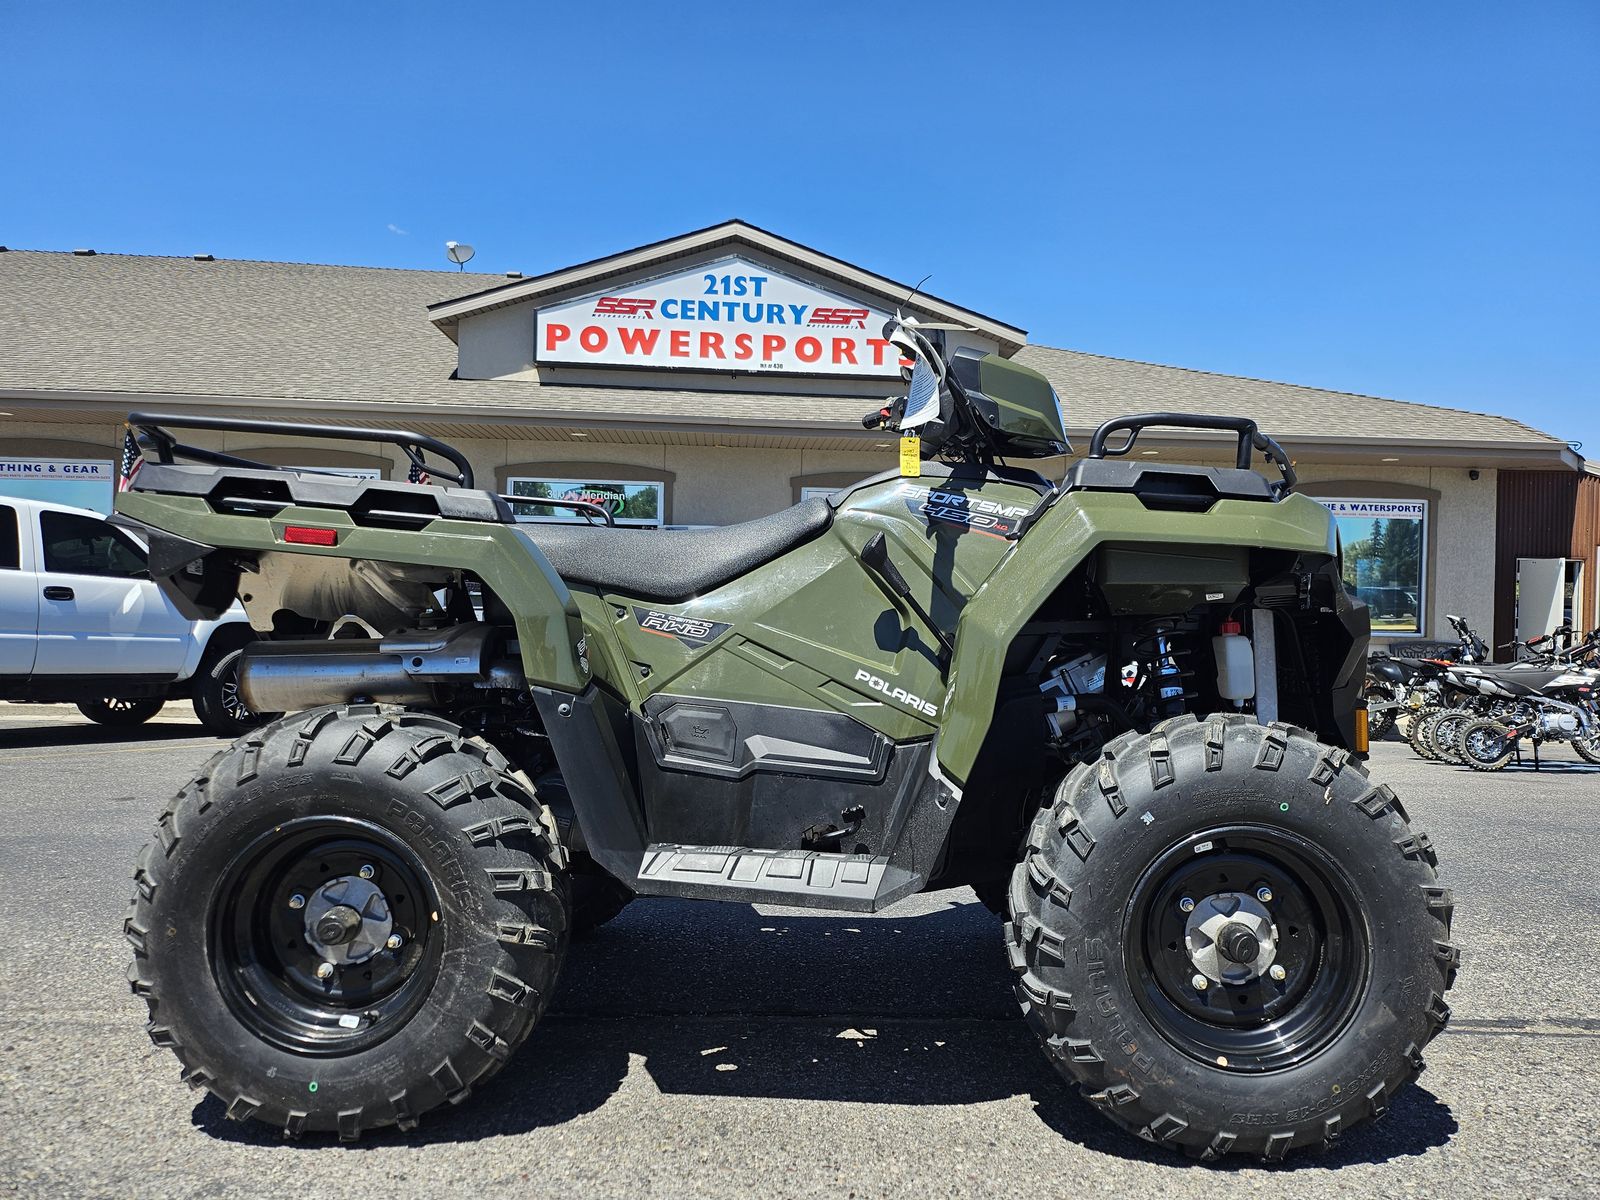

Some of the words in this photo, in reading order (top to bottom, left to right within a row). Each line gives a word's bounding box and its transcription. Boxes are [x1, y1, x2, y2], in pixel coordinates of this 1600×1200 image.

[703, 274, 768, 297] 21ST
[594, 297, 657, 319] SSR
[660, 298, 808, 325] CENTURY
[808, 308, 870, 329] SSR
[48, 464, 57, 473] &
[63, 465, 99, 474] GEAR
[582, 490, 626, 500] Meridian
[1339, 503, 1346, 511] &
[1350, 503, 1423, 513] WATERSPORTS
[641, 616, 710, 638] AWD
[854, 668, 939, 717] POLARIS
[1084, 936, 1156, 1076] POLARIS
